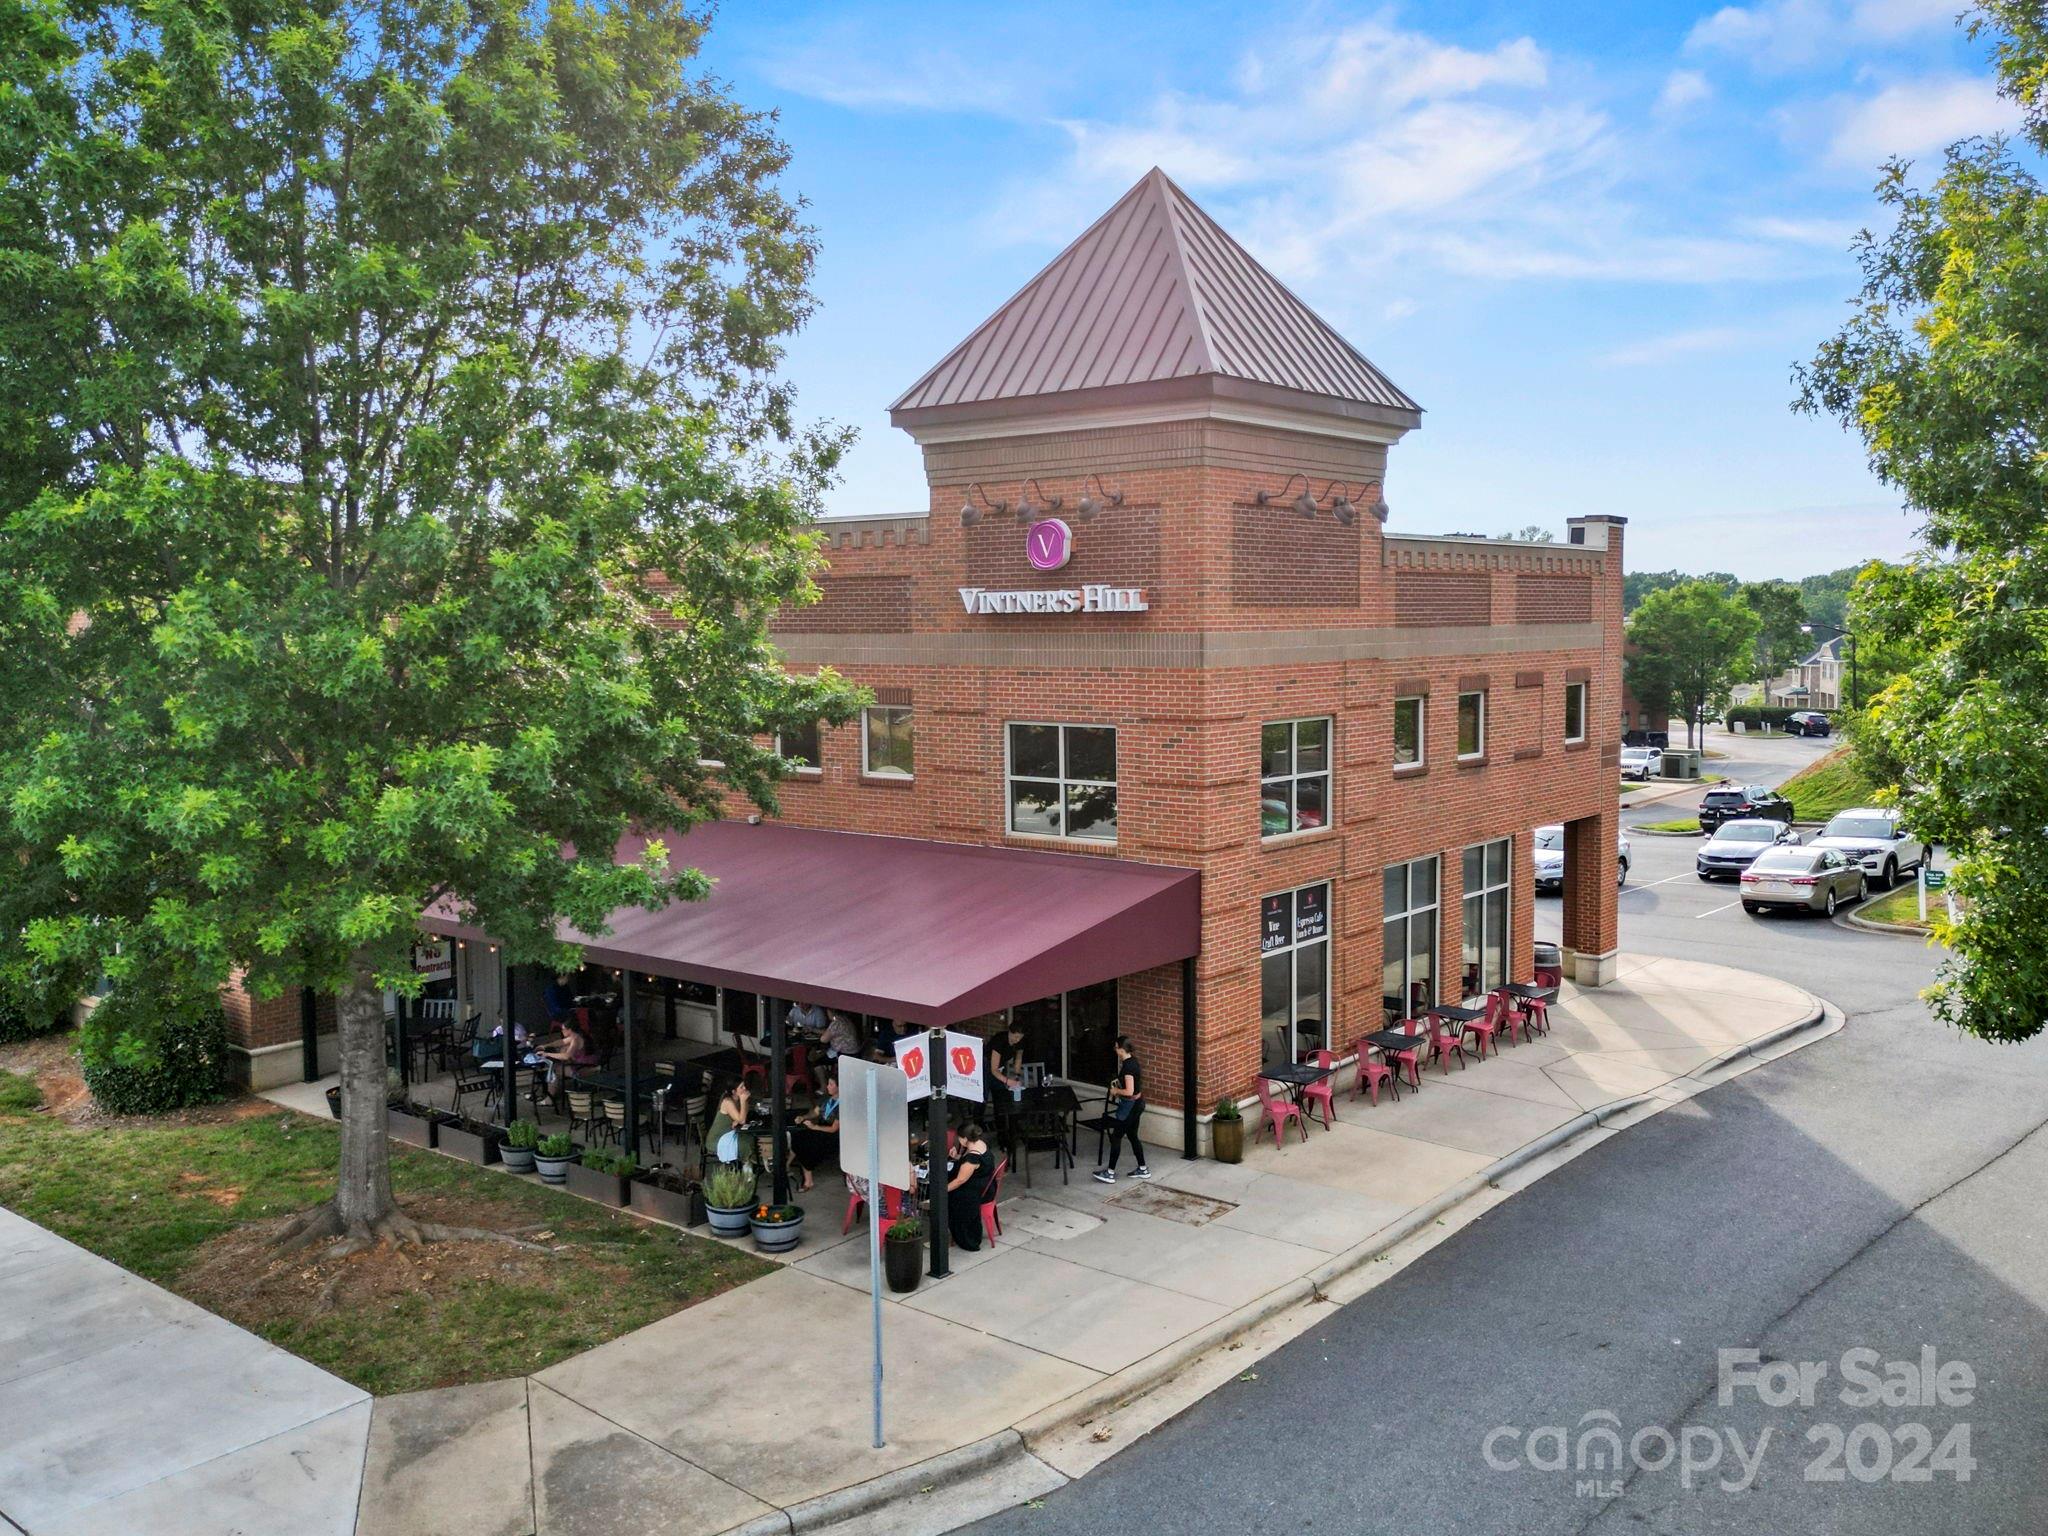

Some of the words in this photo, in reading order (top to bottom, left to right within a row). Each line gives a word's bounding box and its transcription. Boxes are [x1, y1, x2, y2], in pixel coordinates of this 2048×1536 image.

[1038, 533, 1055, 559] V
[959, 587, 1081, 614] VINTNER'S
[1082, 584, 1149, 612] HILL
[909, 1056, 919, 1073] V
[959, 1054, 970, 1072] V
